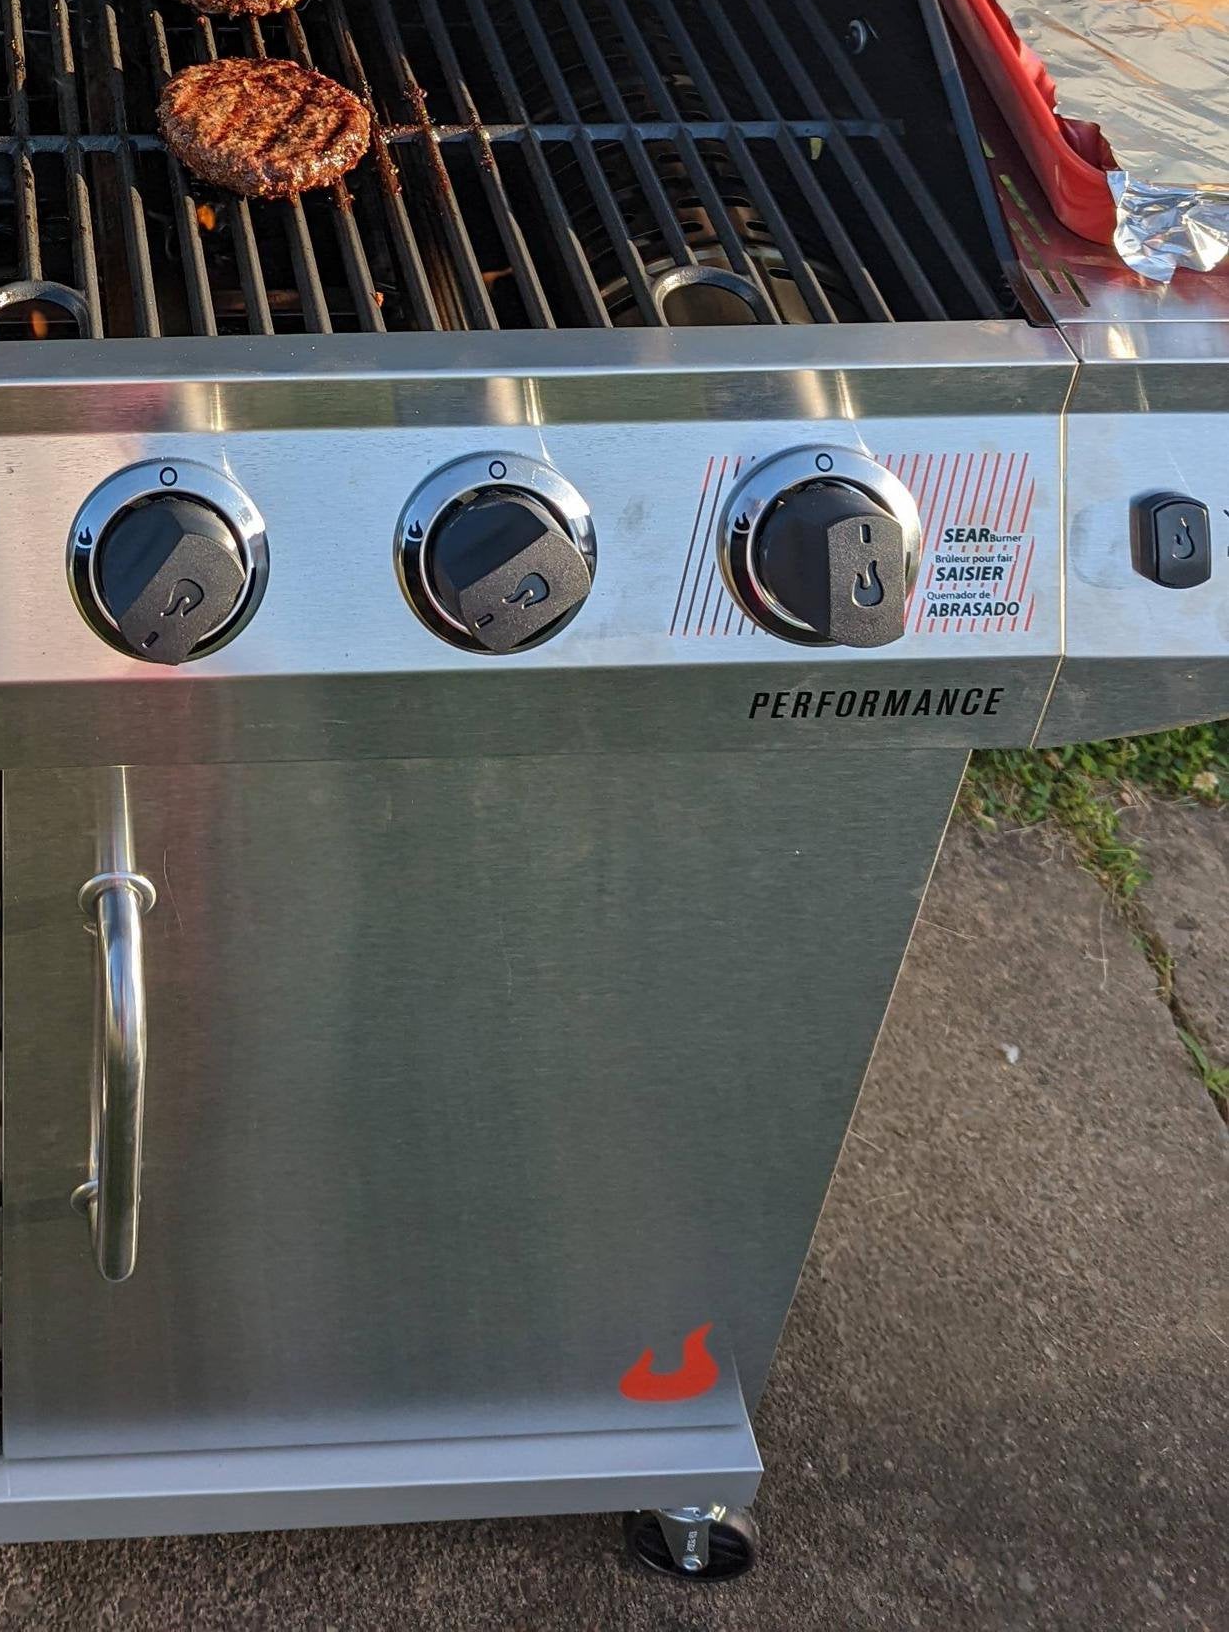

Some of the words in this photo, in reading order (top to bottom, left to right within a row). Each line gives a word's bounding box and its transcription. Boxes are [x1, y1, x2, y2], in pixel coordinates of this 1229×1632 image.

[943, 528, 990, 543] SEAR
[989, 534, 1022, 542] Burner
[972, 555, 994, 564] pour
[936, 566, 1004, 581] SAISIER
[927, 590, 976, 600] Quemador
[978, 590, 990, 599] de
[927, 602, 1019, 617] ABRASADO
[749, 688, 1004, 718] PERFORMANCE
